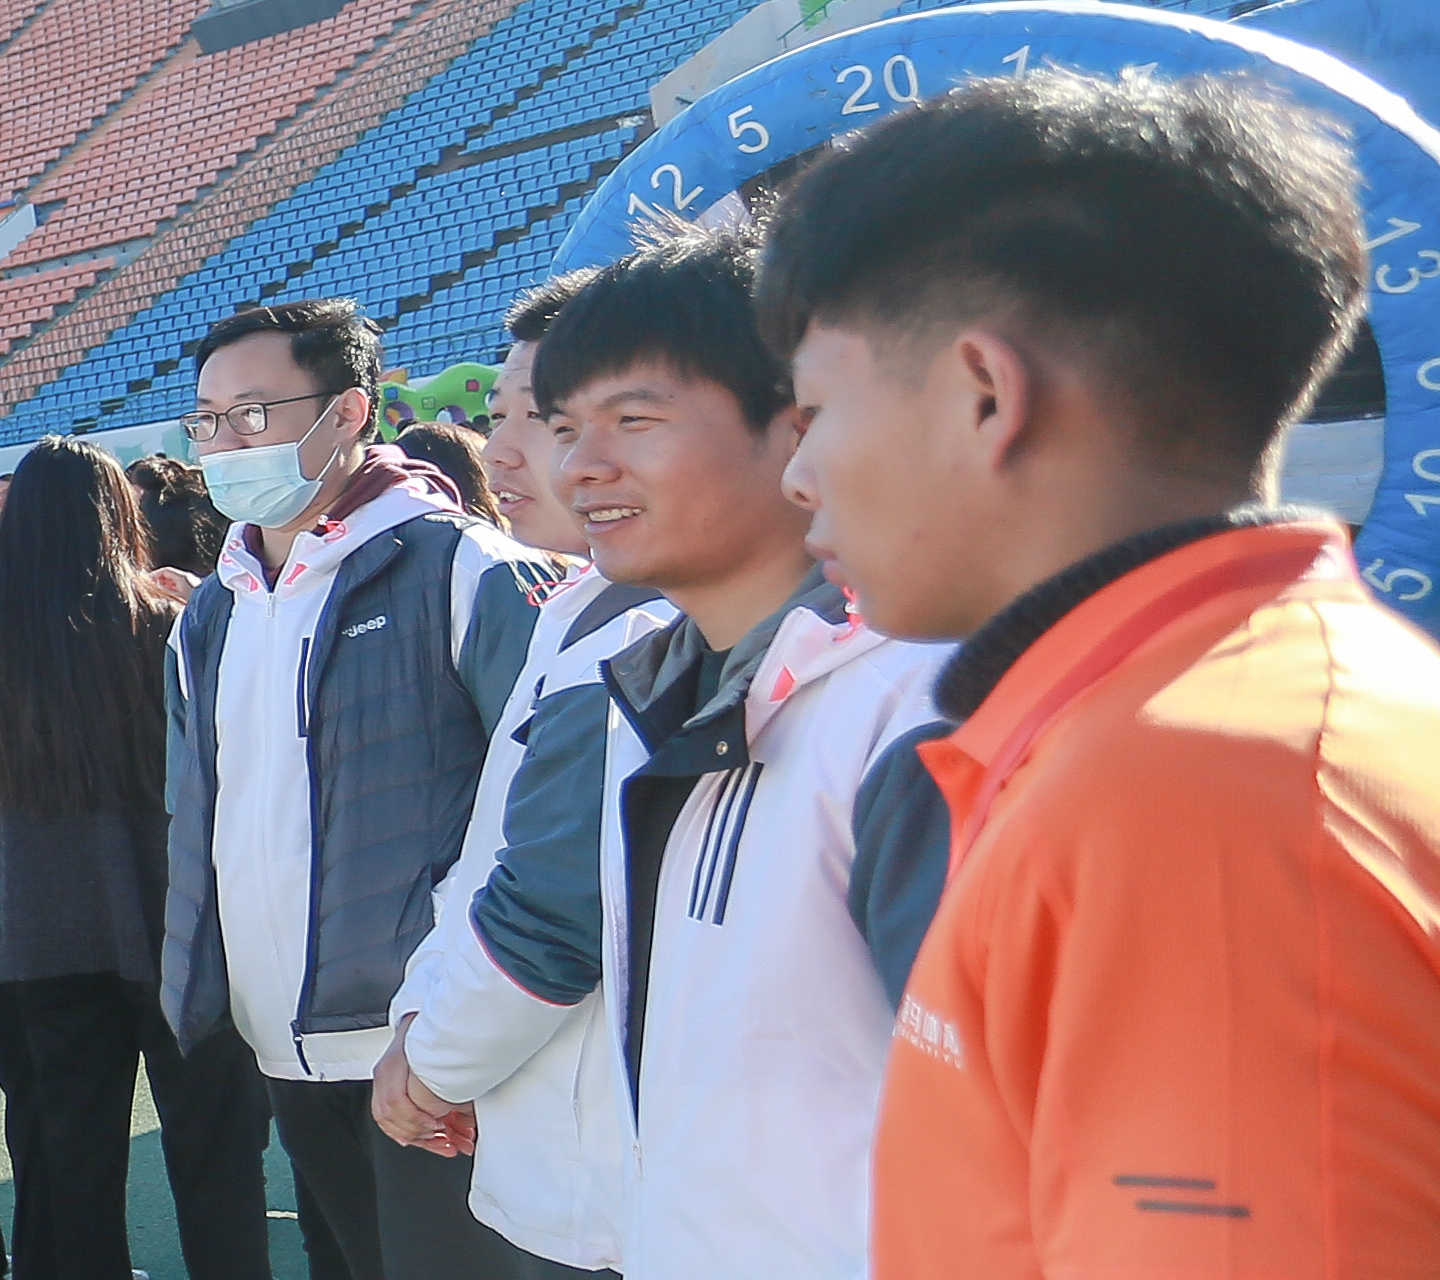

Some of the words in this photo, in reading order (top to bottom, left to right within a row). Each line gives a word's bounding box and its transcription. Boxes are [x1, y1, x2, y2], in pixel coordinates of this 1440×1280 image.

[836, 54, 920, 116] 20
[727, 105, 770, 154] 5
[626, 164, 704, 222] 12
[348, 615, 386, 637] Jeep
